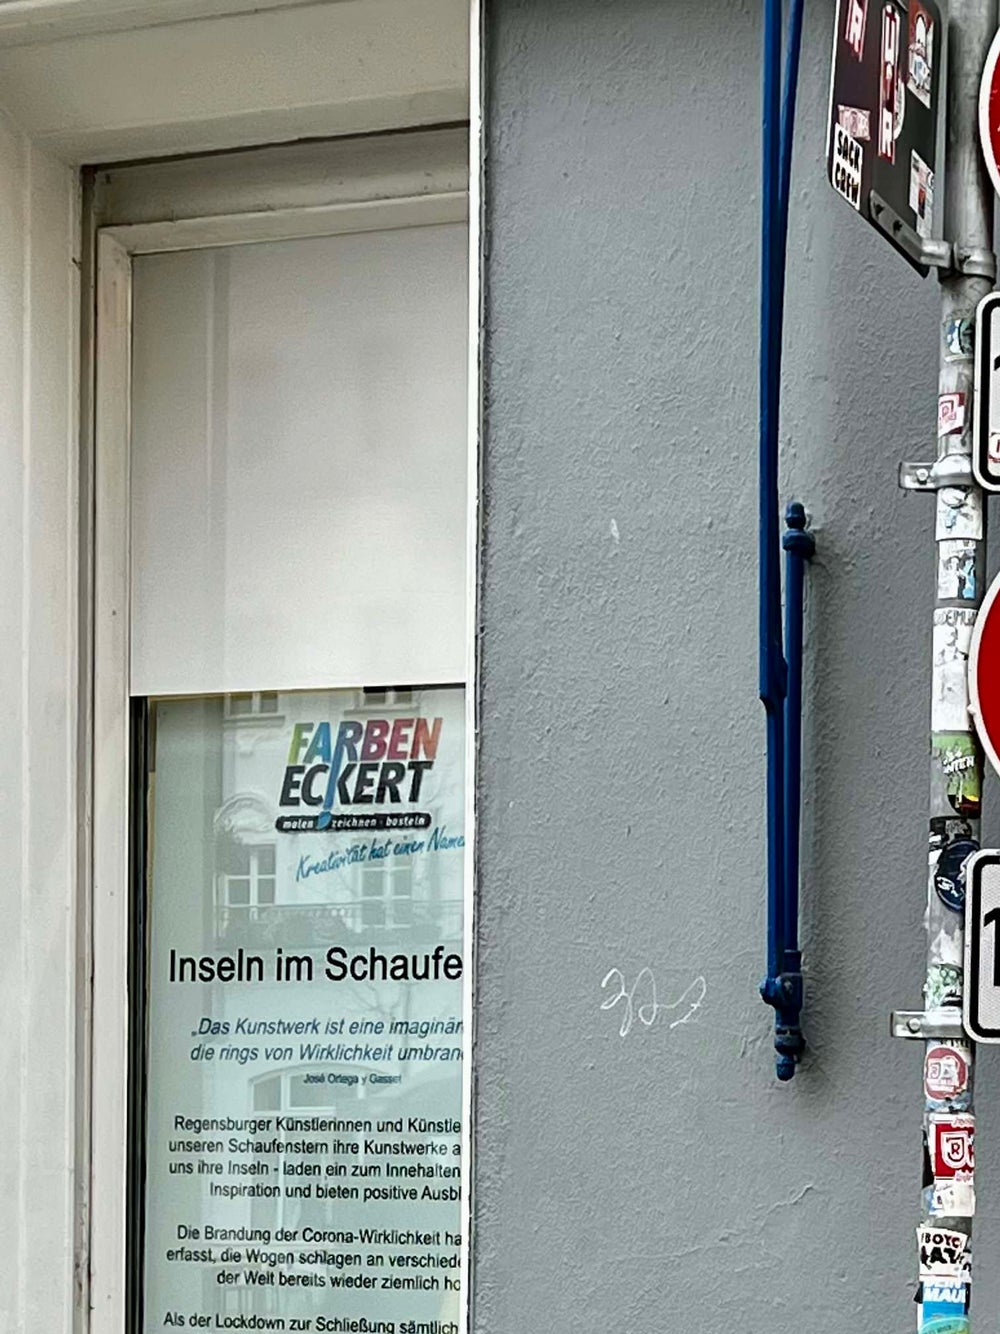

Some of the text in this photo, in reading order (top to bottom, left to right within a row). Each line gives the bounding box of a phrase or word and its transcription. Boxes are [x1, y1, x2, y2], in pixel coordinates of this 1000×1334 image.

[289, 718, 443, 764] FARBEN
[280, 761, 433, 807] ECKERT
[331, 817, 376, 828] zeichnen
[296, 836, 424, 882] Kreativität hat einen
[169, 946, 462, 982] Inseln im Schaufe
[235, 1018, 321, 1034] Kunstwerk
[325, 1019, 344, 1034] ist
[349, 1020, 384, 1034] eine
[191, 1044, 393, 1065] die rings von Wirklichkeit
[304, 1074, 324, 1083] José
[175, 1115, 402, 1134] Regensburger Künstlerinnen und
[169, 1138, 447, 1155] unseren Schaufenstern ihre Kunstwerke
[170, 1160, 460, 1178] uns ihre Inseln laden ein zum Innehalten
[210, 1182, 417, 1202] Inspiration und bieten positive
[177, 1225, 440, 1246] Die Brandung der Corona-Wirklichkeit
[167, 1247, 384, 1269] erfasst, die Wogen schlagen an
[217, 1270, 439, 1290] der Welt bereits wieder ziemlich
[164, 1312, 185, 1326] Als
[189, 1313, 211, 1327] der
[216, 1314, 284, 1329] Lockdown
[289, 1319, 311, 1331] zur
